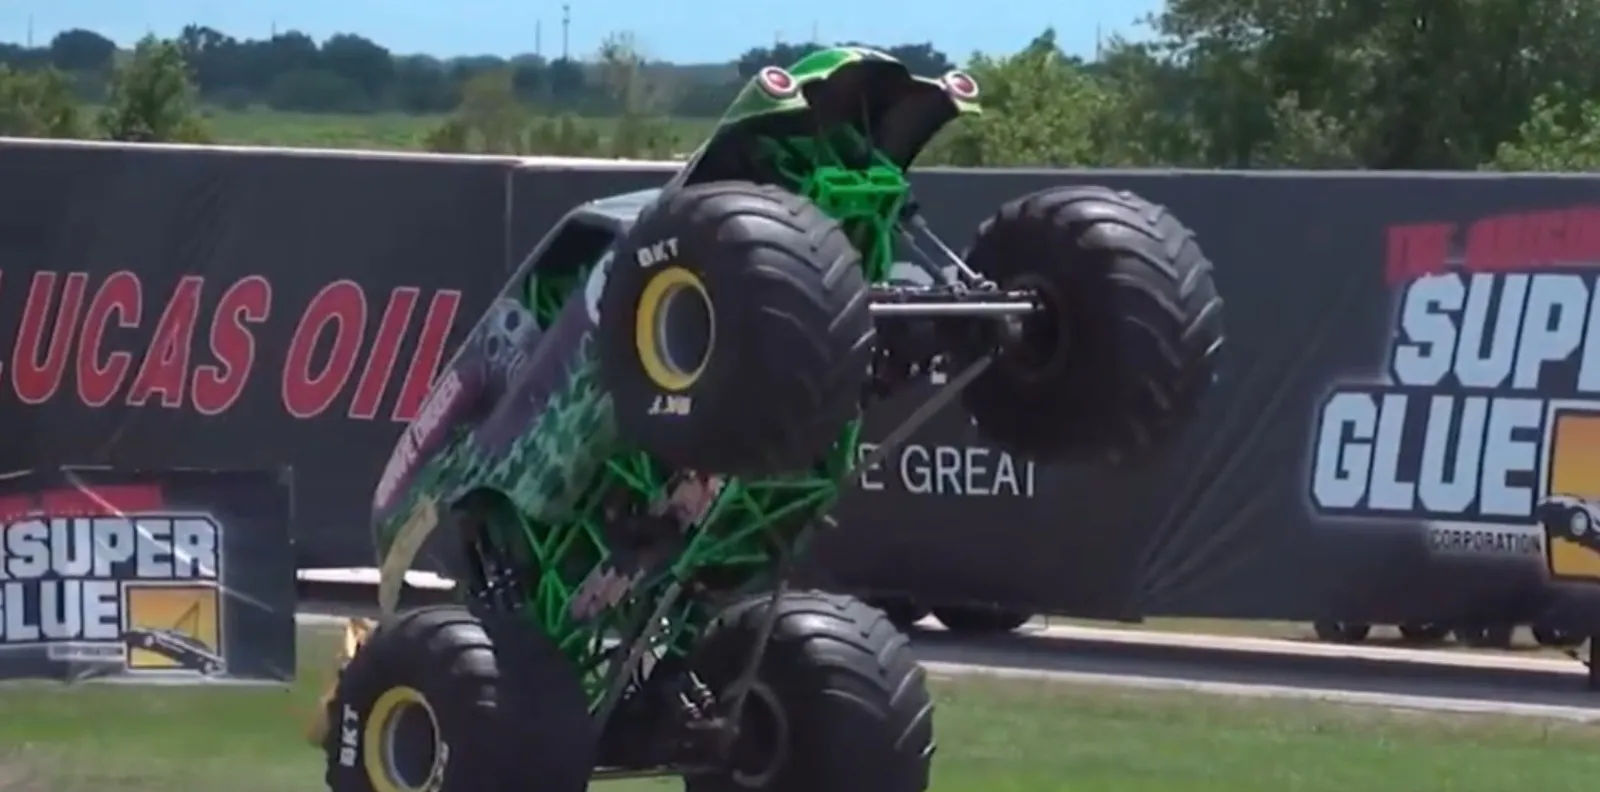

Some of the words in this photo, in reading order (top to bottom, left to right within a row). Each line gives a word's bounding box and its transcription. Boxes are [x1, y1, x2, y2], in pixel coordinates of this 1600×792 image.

[0, 271, 271, 415] UCAS
[1313, 393, 1543, 516] GLUE
[6, 518, 216, 578] SUPER
[1430, 528, 1542, 554] CORPORATION
[0, 580, 119, 641] LUE
[340, 703, 359, 768] BKT
